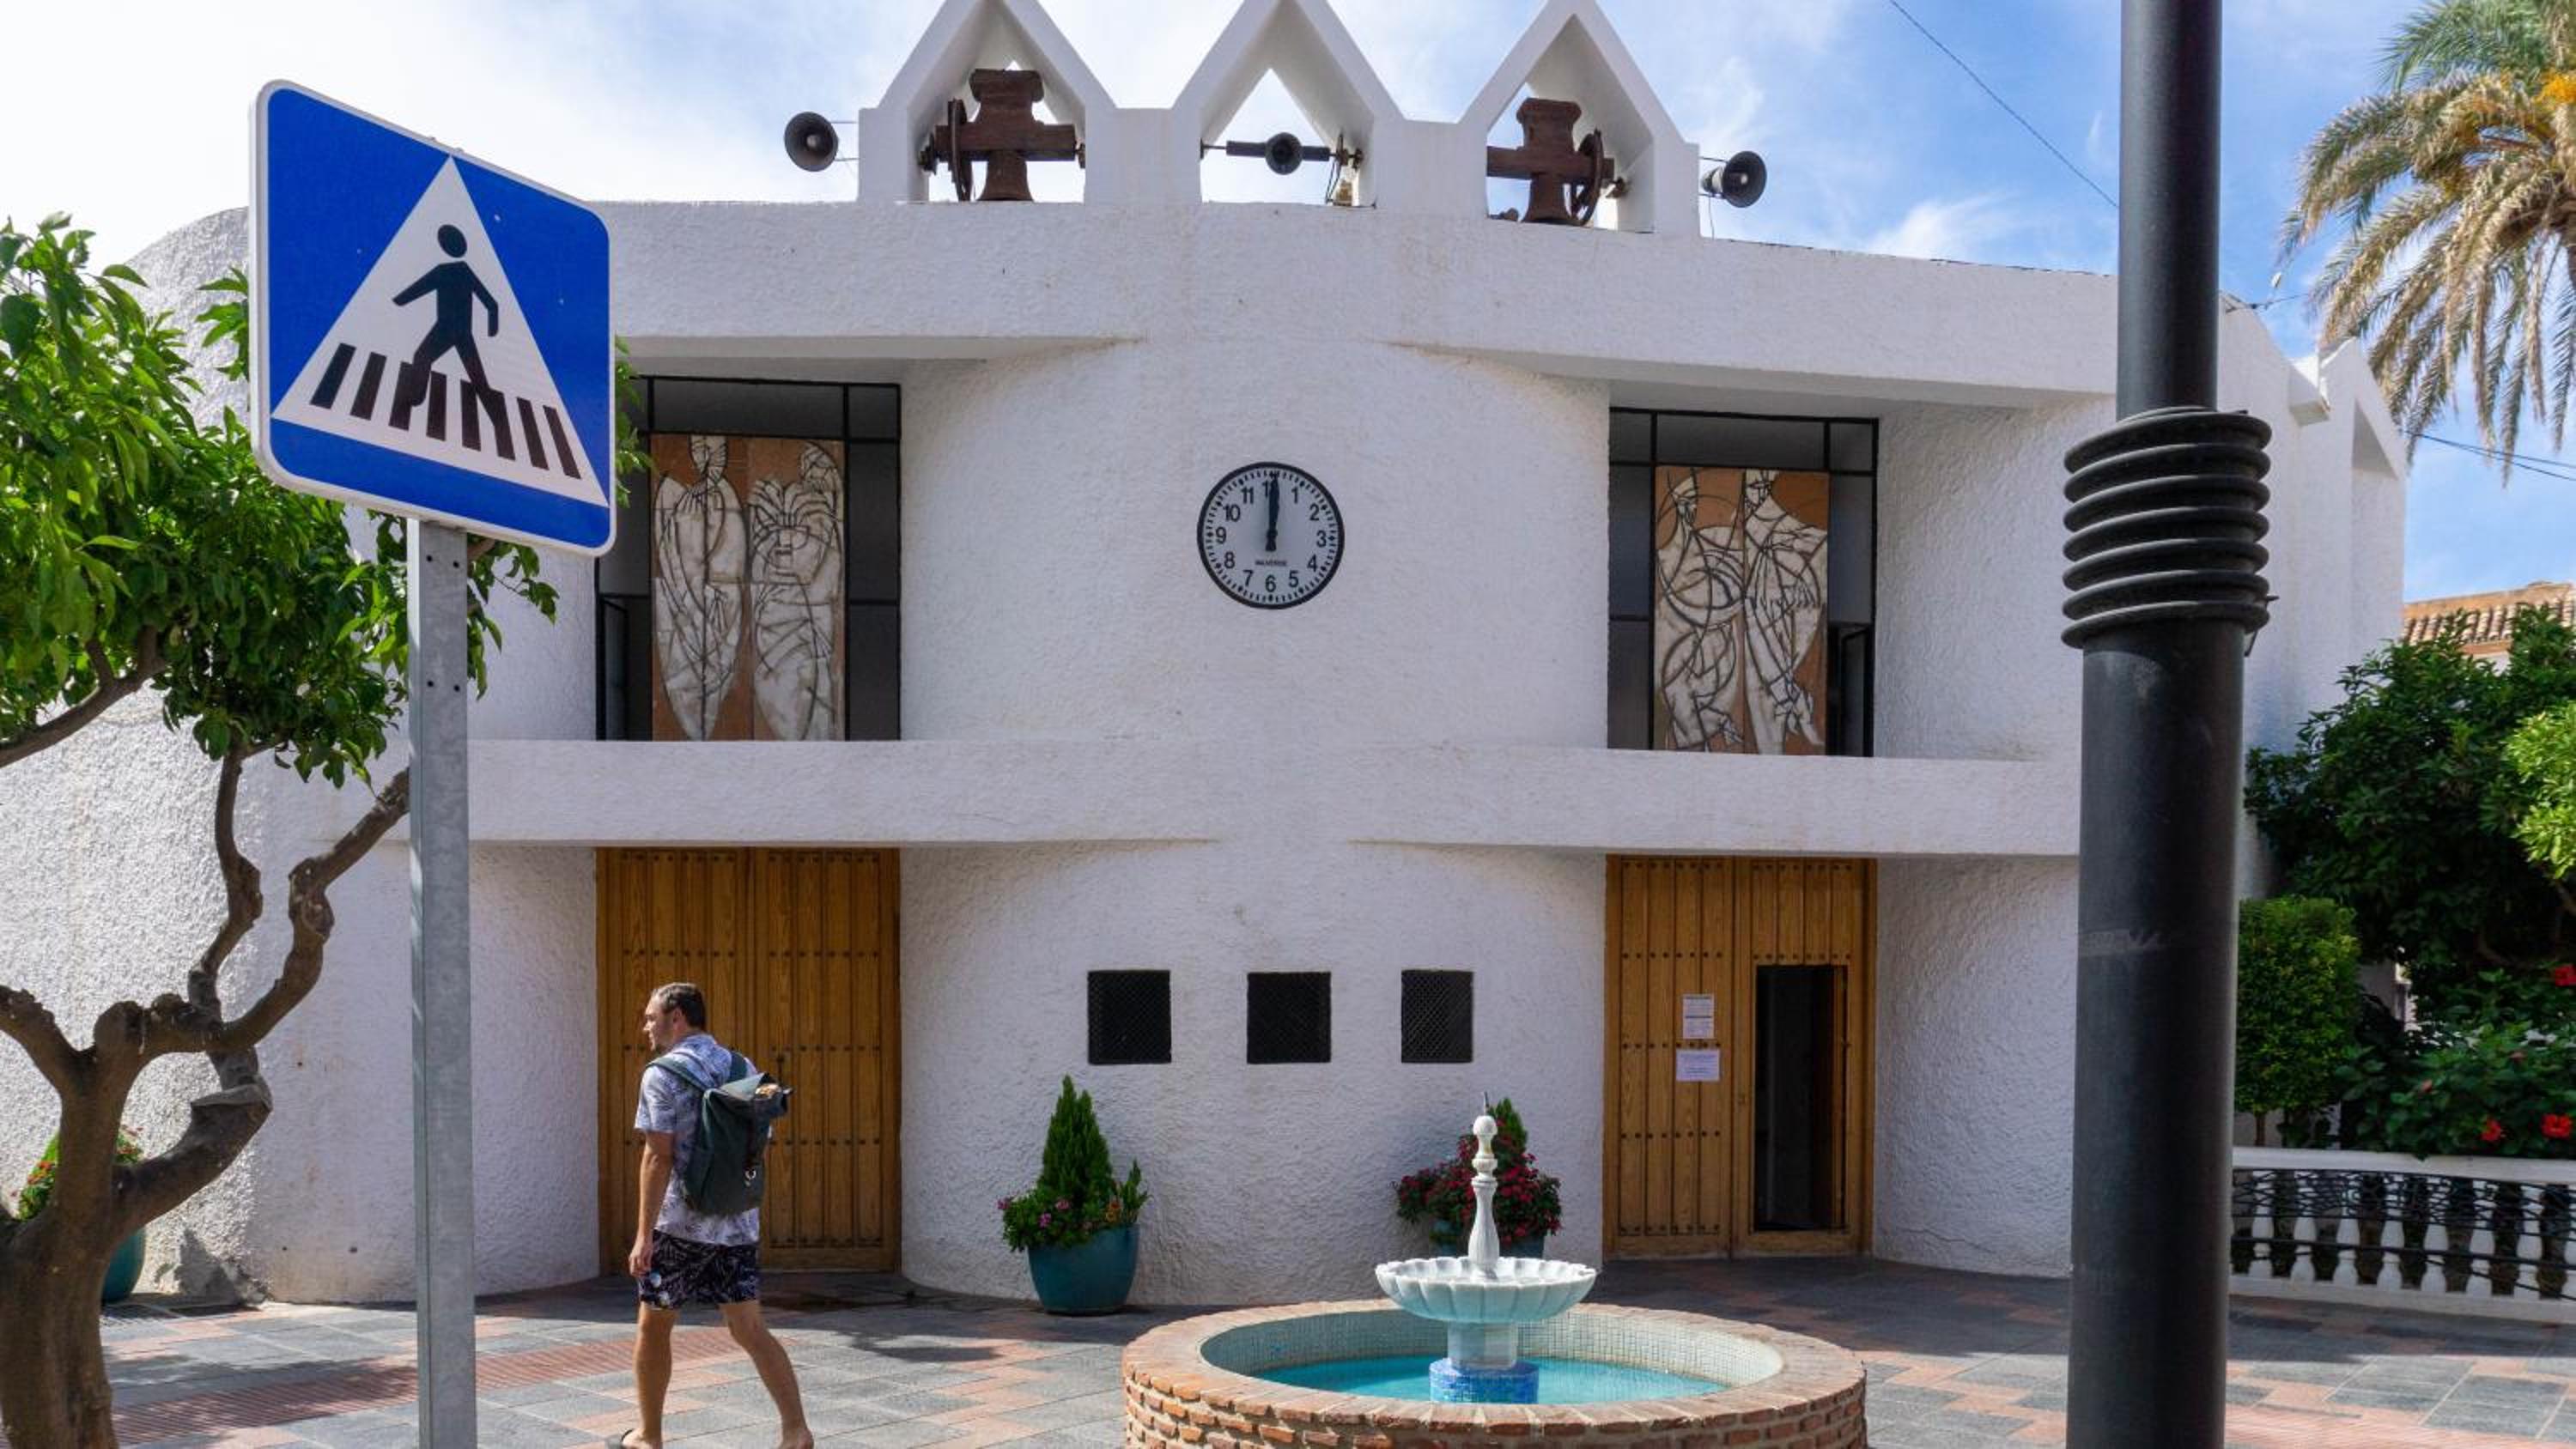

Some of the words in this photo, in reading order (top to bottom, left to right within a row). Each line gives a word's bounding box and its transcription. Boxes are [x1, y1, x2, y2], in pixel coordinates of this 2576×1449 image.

[1241, 487, 1255, 504] 11
[1291, 486, 1298, 504] 1
[1223, 504, 1241, 522] 10
[1309, 503, 1320, 521] 2
[1215, 526, 1226, 544] 9
[1316, 530, 1327, 548] 3
[1224, 551, 1235, 569] 8
[1307, 554, 1318, 572] 4
[1243, 569, 1254, 586] 7
[1265, 574, 1277, 592] 6
[1289, 570, 1299, 588] 5
